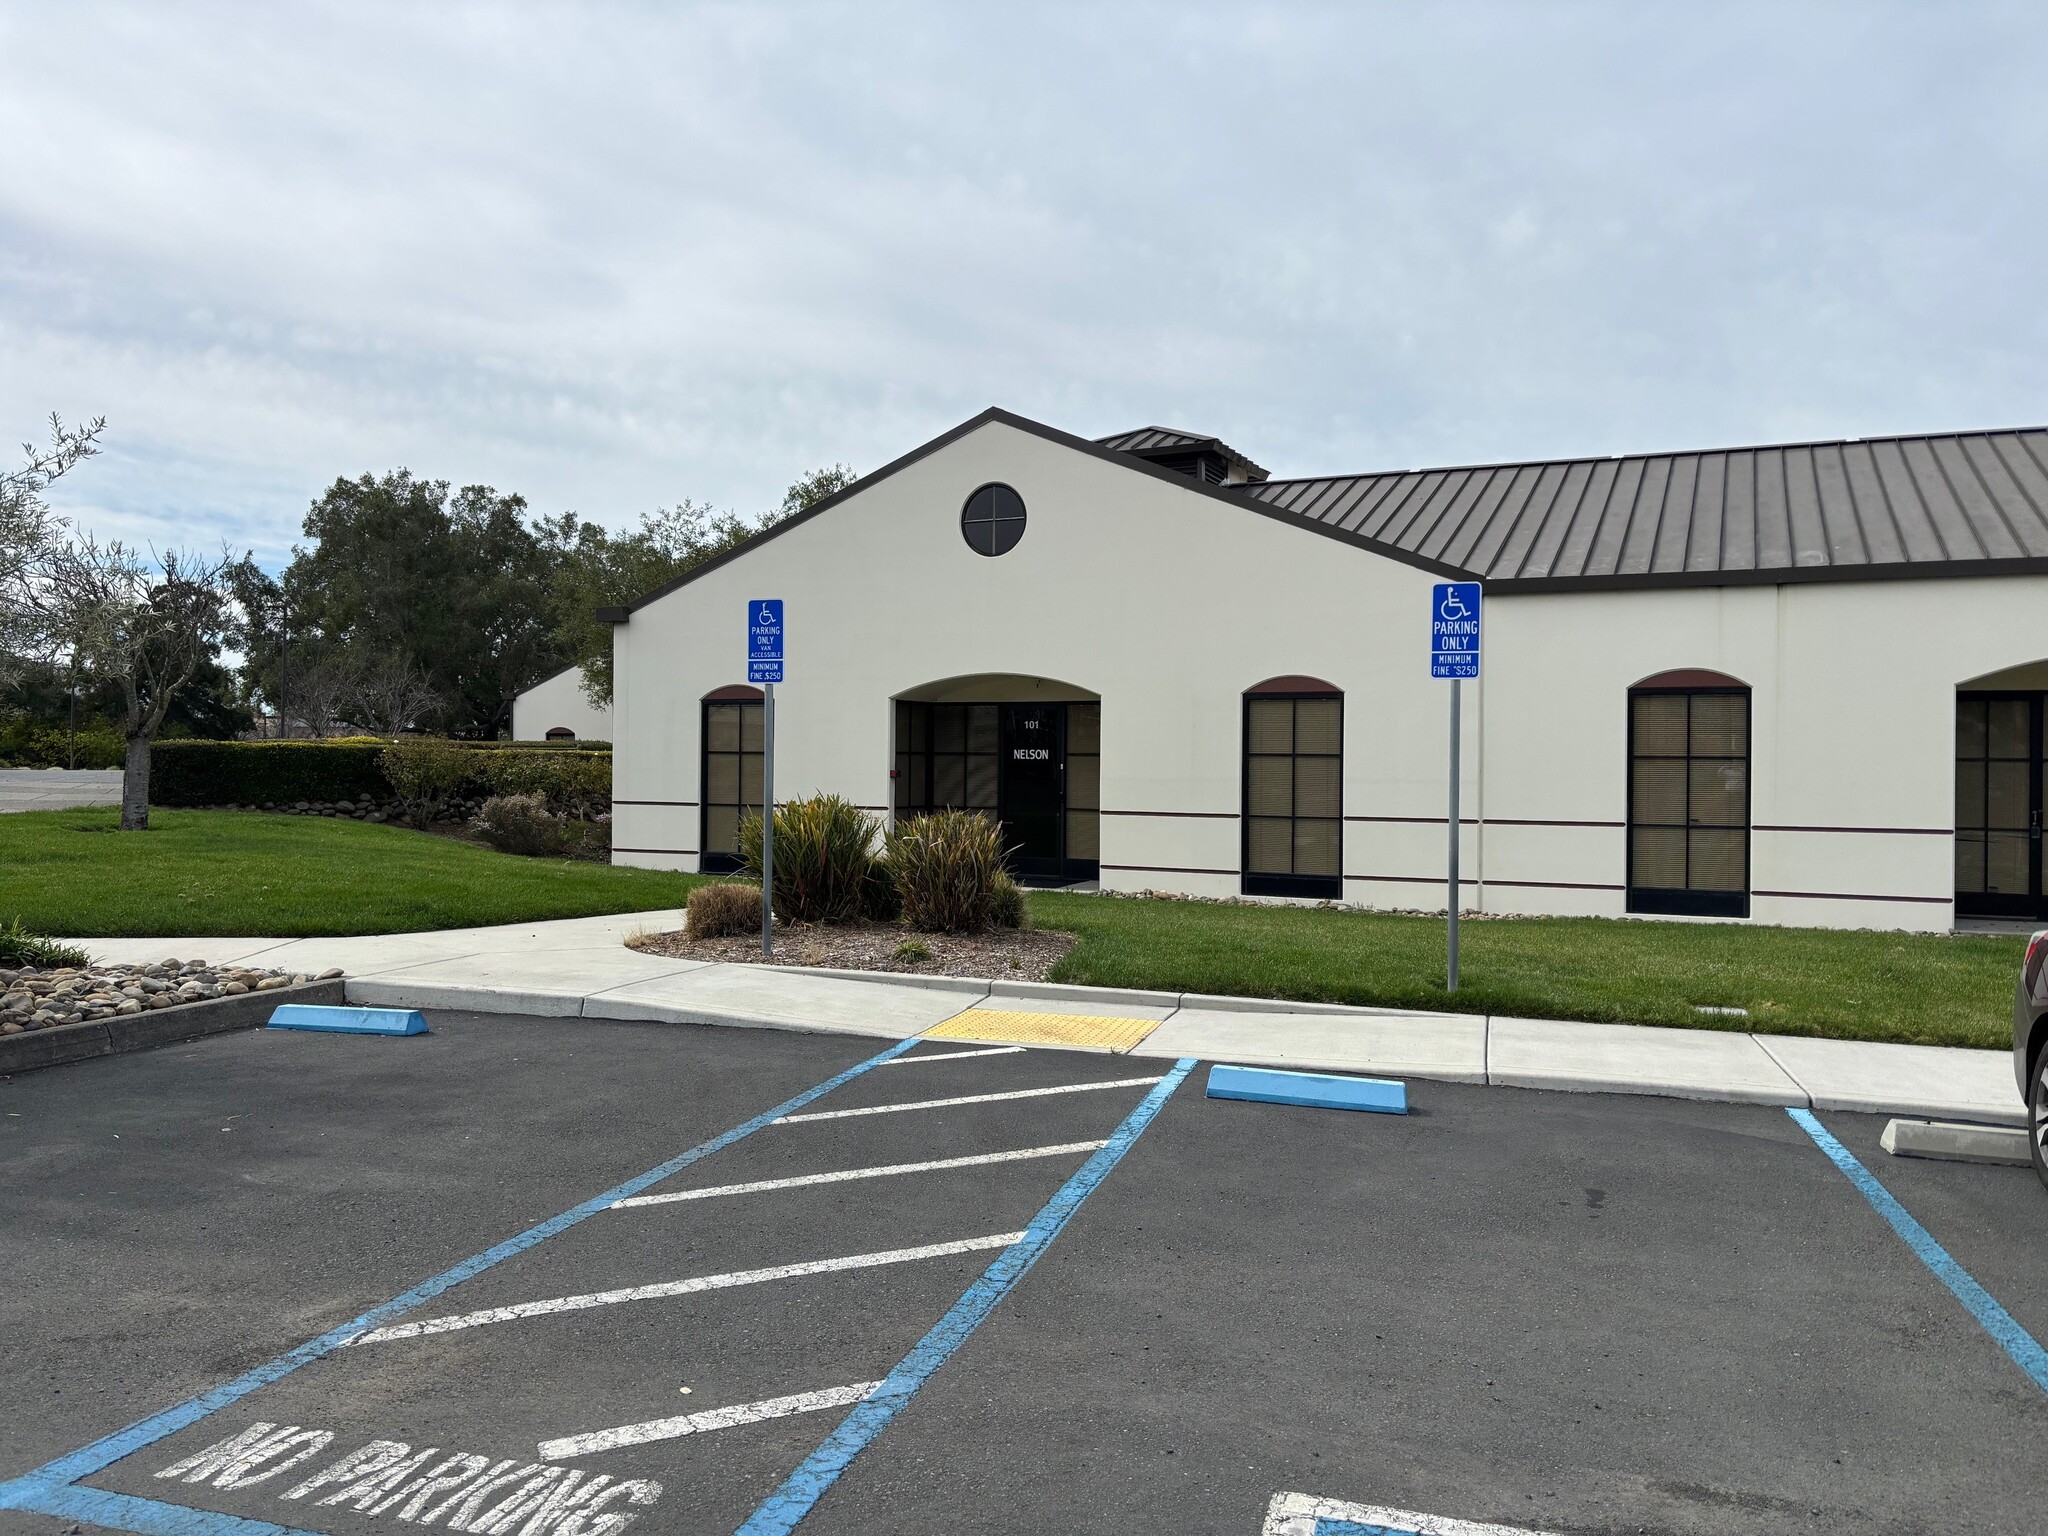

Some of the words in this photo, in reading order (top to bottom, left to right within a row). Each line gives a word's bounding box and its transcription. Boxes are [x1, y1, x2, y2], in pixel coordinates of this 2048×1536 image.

[752, 626, 780, 634] PARKING
[1434, 620, 1478, 634] PARKING
[758, 636, 774, 644] ONLY
[1442, 636, 1469, 650] ONLY
[1438, 654, 1472, 664] MINIMUM
[1433, 666, 1450, 675] FINE
[1024, 720, 1038, 728] 101
[1014, 749, 1048, 760] NELSON
[153, 1421, 335, 1491] NO
[278, 1439, 663, 1536] PARKING
